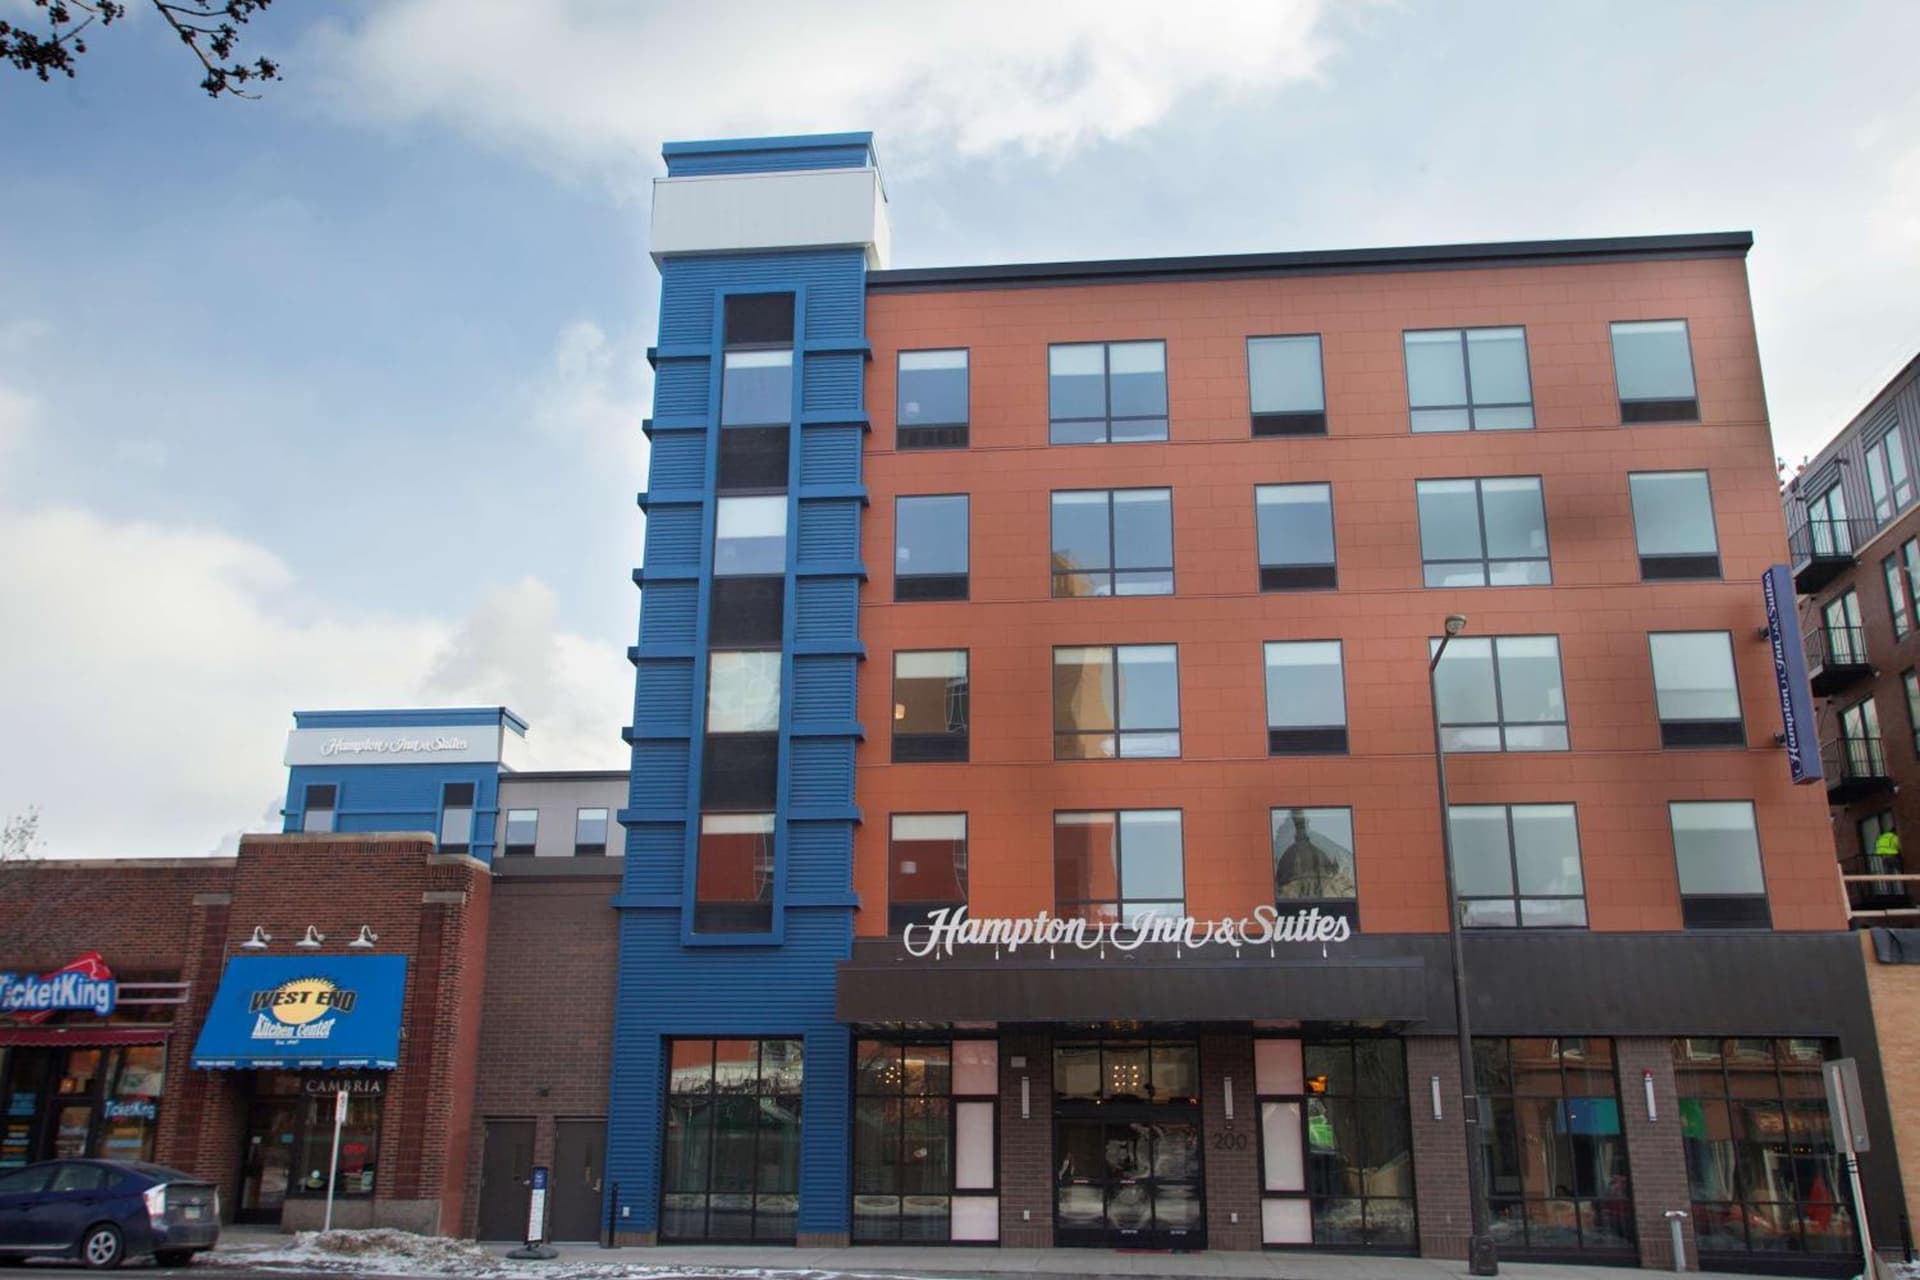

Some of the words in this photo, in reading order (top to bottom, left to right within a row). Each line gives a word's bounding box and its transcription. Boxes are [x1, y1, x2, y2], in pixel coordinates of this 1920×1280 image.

[1764, 572, 1778, 620] Suites
[1774, 632, 1787, 677] Inn
[1781, 681, 1802, 774] Hampton
[320, 737, 389, 757] Hampton
[390, 737, 422, 753] Inn
[428, 736, 468, 752] Suites
[903, 904, 1104, 957] Hampton
[1110, 910, 1213, 950] Inn
[1214, 917, 1244, 947] &
[1238, 905, 1350, 944] Suites
[248, 990, 313, 1013] WEST
[315, 989, 357, 1013] END
[251, 1013, 295, 1039] Kitchen
[296, 1018, 336, 1039] Center
[305, 1080, 382, 1093] CAMBRIA
[1215, 1133, 1248, 1151] 200
